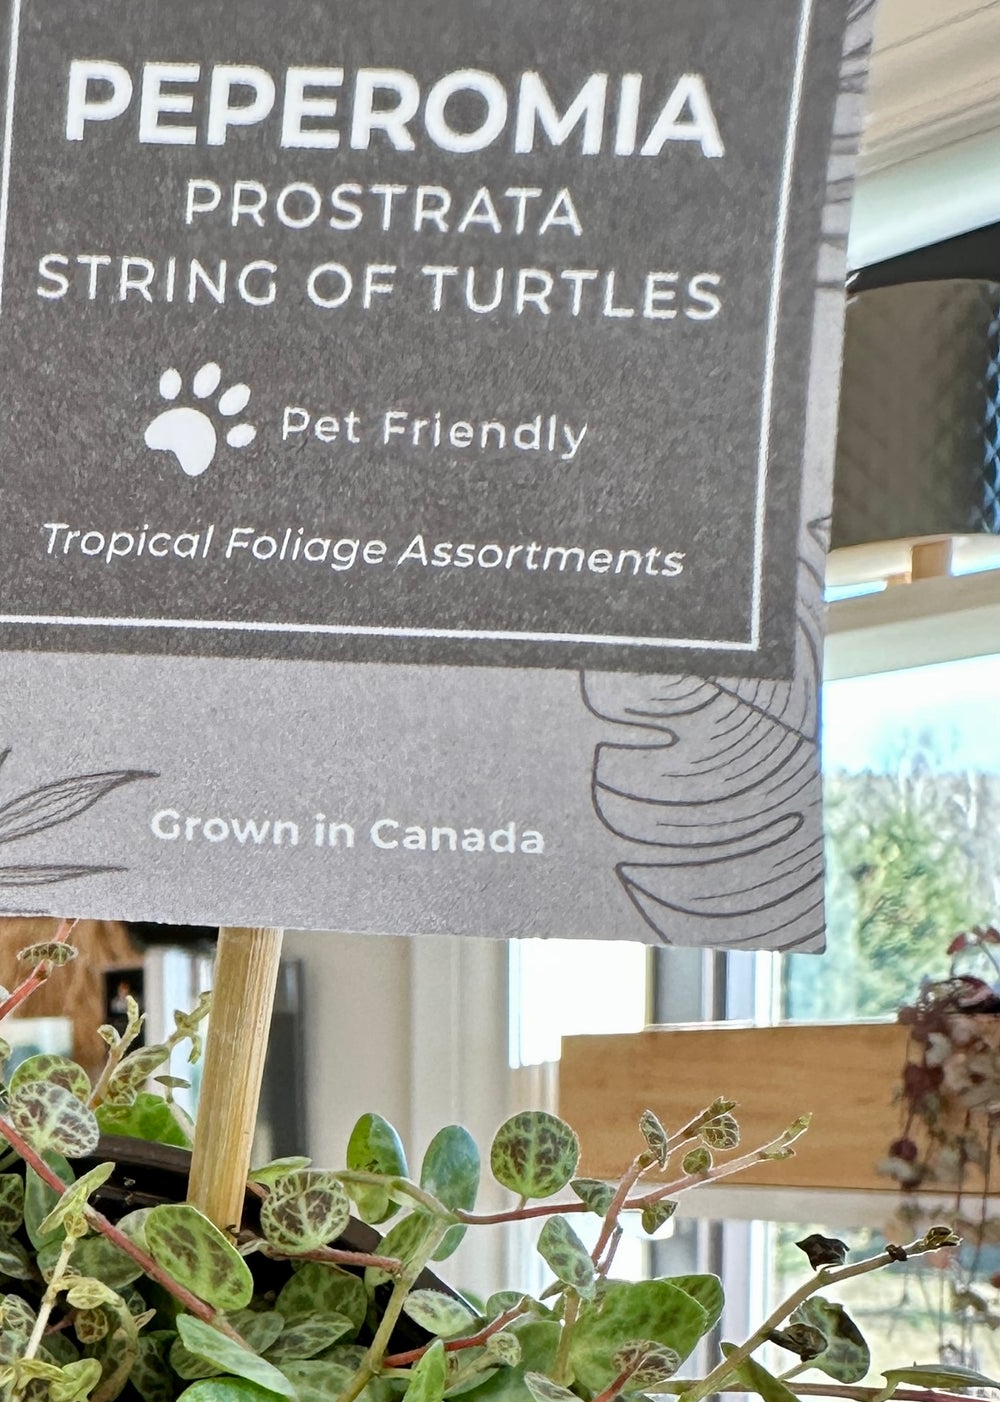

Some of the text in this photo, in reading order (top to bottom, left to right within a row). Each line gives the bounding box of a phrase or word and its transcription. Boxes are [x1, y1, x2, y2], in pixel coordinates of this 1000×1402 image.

[65, 59, 725, 158] PEPEROMIA
[185, 179, 583, 236] PROSTRATA
[36, 253, 722, 320] STRING OF TURTLES
[282, 406, 589, 460] Pet Friendly
[42, 522, 685, 577] Tropical Foliage Assortments
[150, 808, 545, 854] Grown in Canada
